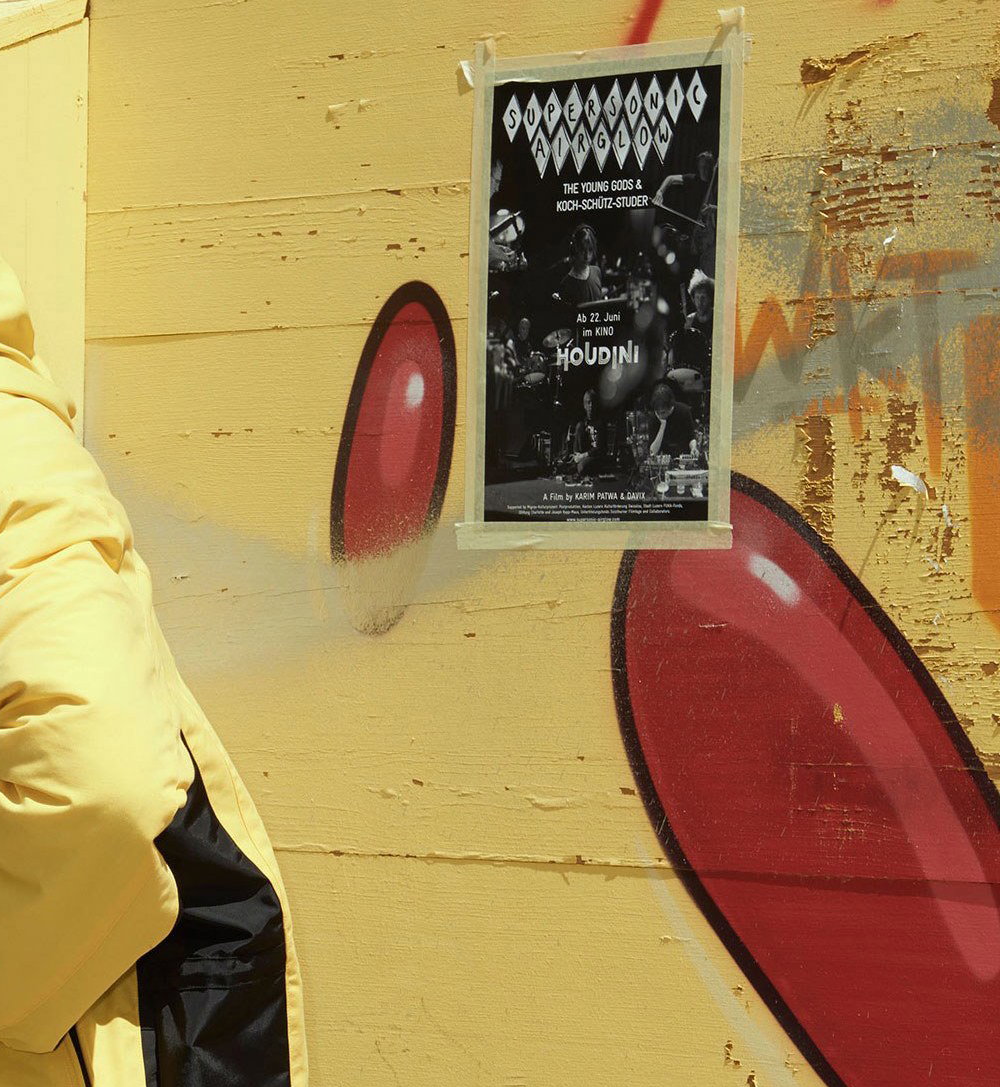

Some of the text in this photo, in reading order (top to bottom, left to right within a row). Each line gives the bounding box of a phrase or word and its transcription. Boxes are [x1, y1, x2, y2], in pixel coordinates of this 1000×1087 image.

[506, 86, 703, 132] SUPERSONIC
[533, 121, 671, 164] AIRGLOW
[563, 180, 642, 194] THE YOUNG GODS &
[556, 194, 648, 212] KOCH-SCHÜTZ-STUDER
[576, 310, 620, 323] Ab 22. Juni
[582, 326, 614, 336] im KINO
[557, 340, 639, 371] HOUDINI
[542, 492, 548, 501] A
[550, 492, 564, 501] Film
[565, 492, 574, 502] by
[574, 492, 596, 500] KARIM
[597, 492, 618, 500] PATWA
